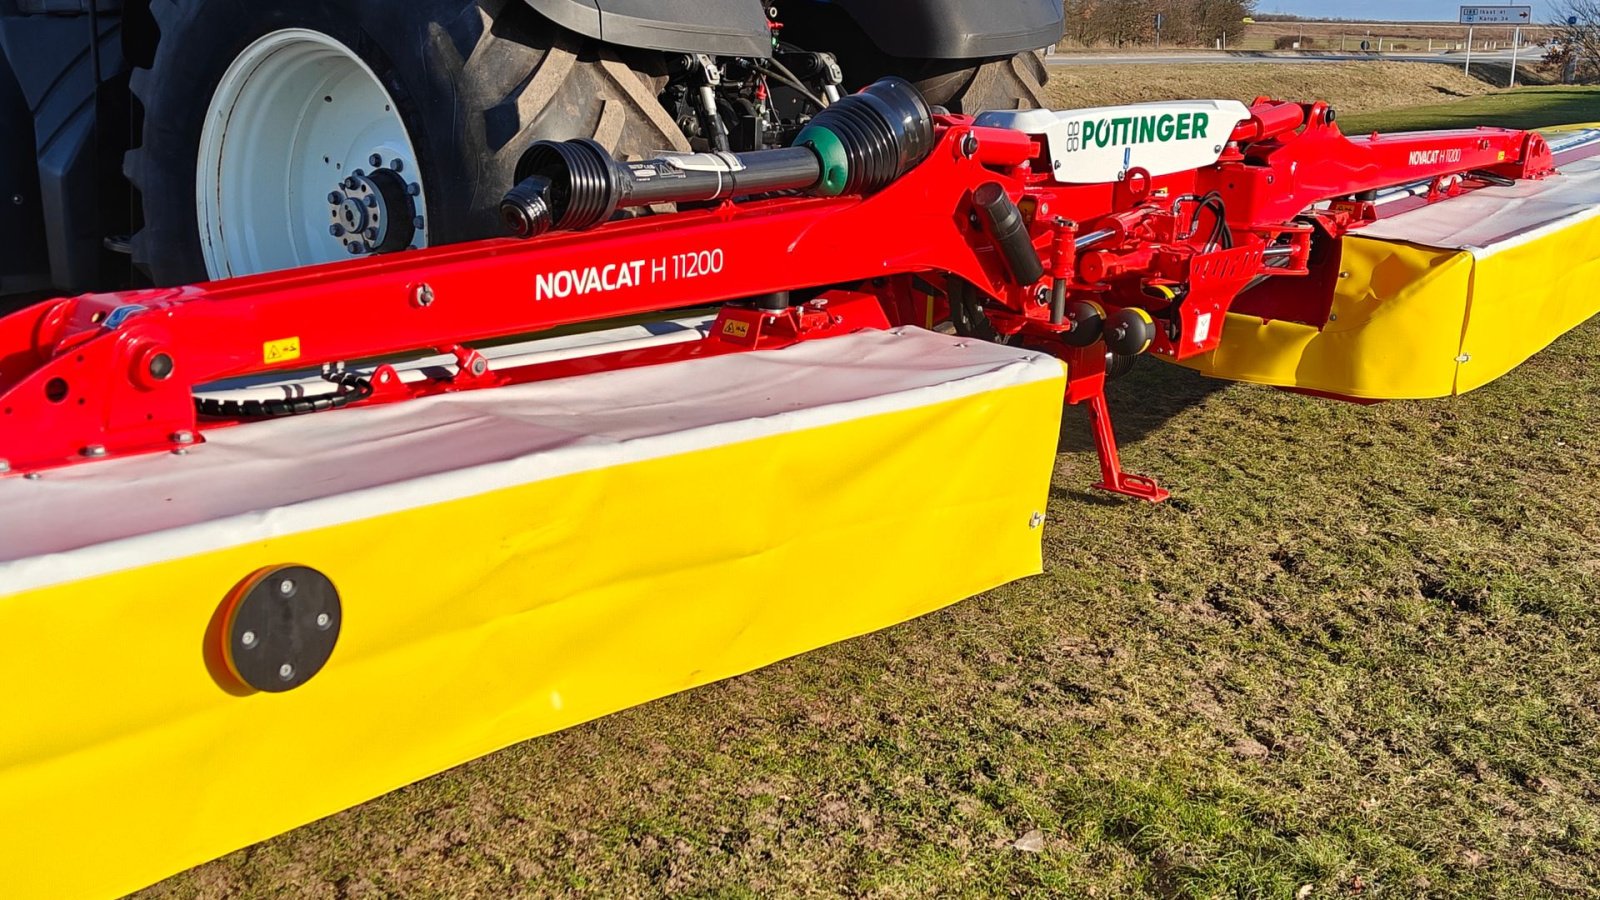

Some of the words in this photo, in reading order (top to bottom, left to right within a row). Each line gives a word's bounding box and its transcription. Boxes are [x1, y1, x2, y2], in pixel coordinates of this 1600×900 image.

[1081, 112, 1209, 150] PÖTTINGER
[1408, 150, 1440, 166] NOVACAT
[1440, 150, 1445, 163] H
[1446, 149, 1461, 163] 11200
[535, 259, 645, 301] NOVACAT
[651, 257, 667, 283] H
[672, 248, 724, 280] 11200
